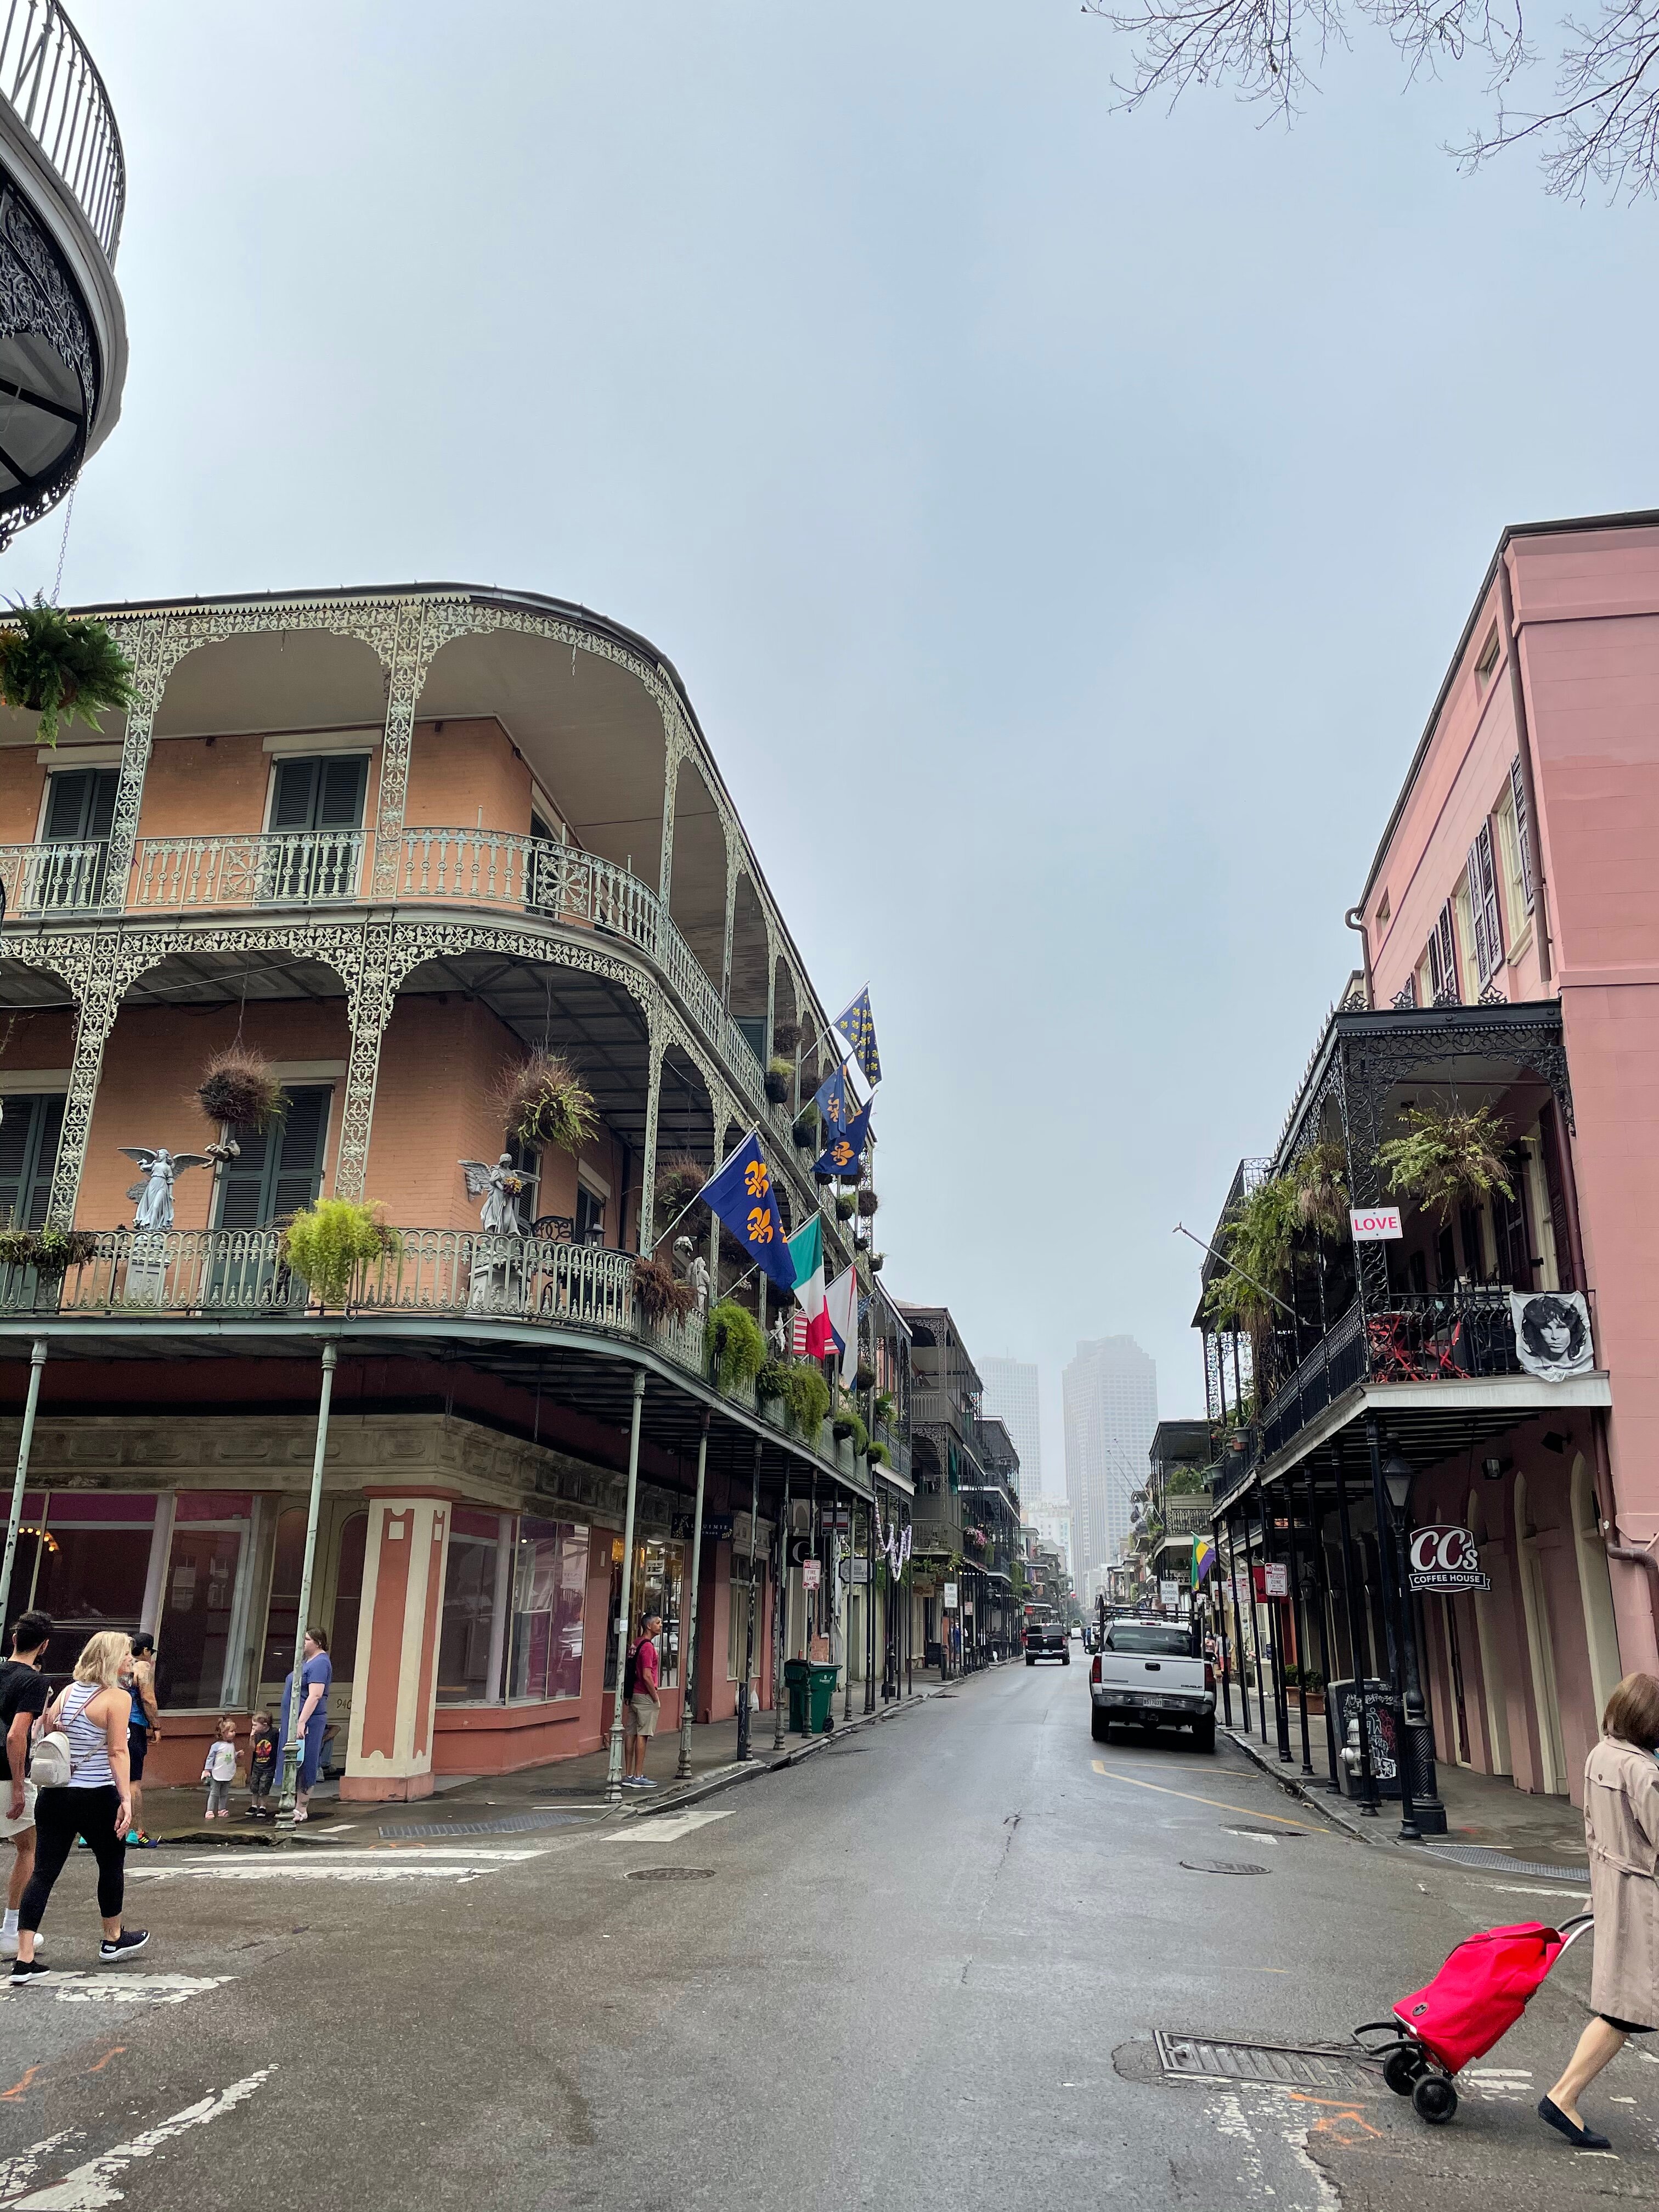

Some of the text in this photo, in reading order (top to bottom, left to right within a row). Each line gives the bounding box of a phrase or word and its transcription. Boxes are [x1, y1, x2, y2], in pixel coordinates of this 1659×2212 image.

[1354, 1216, 1398, 1231] LOVE
[683, 1521, 729, 1530] ALUIMIE
[1410, 1530, 1479, 1571] CC's
[1414, 1574, 1480, 1584] COFFEE HOUSE
